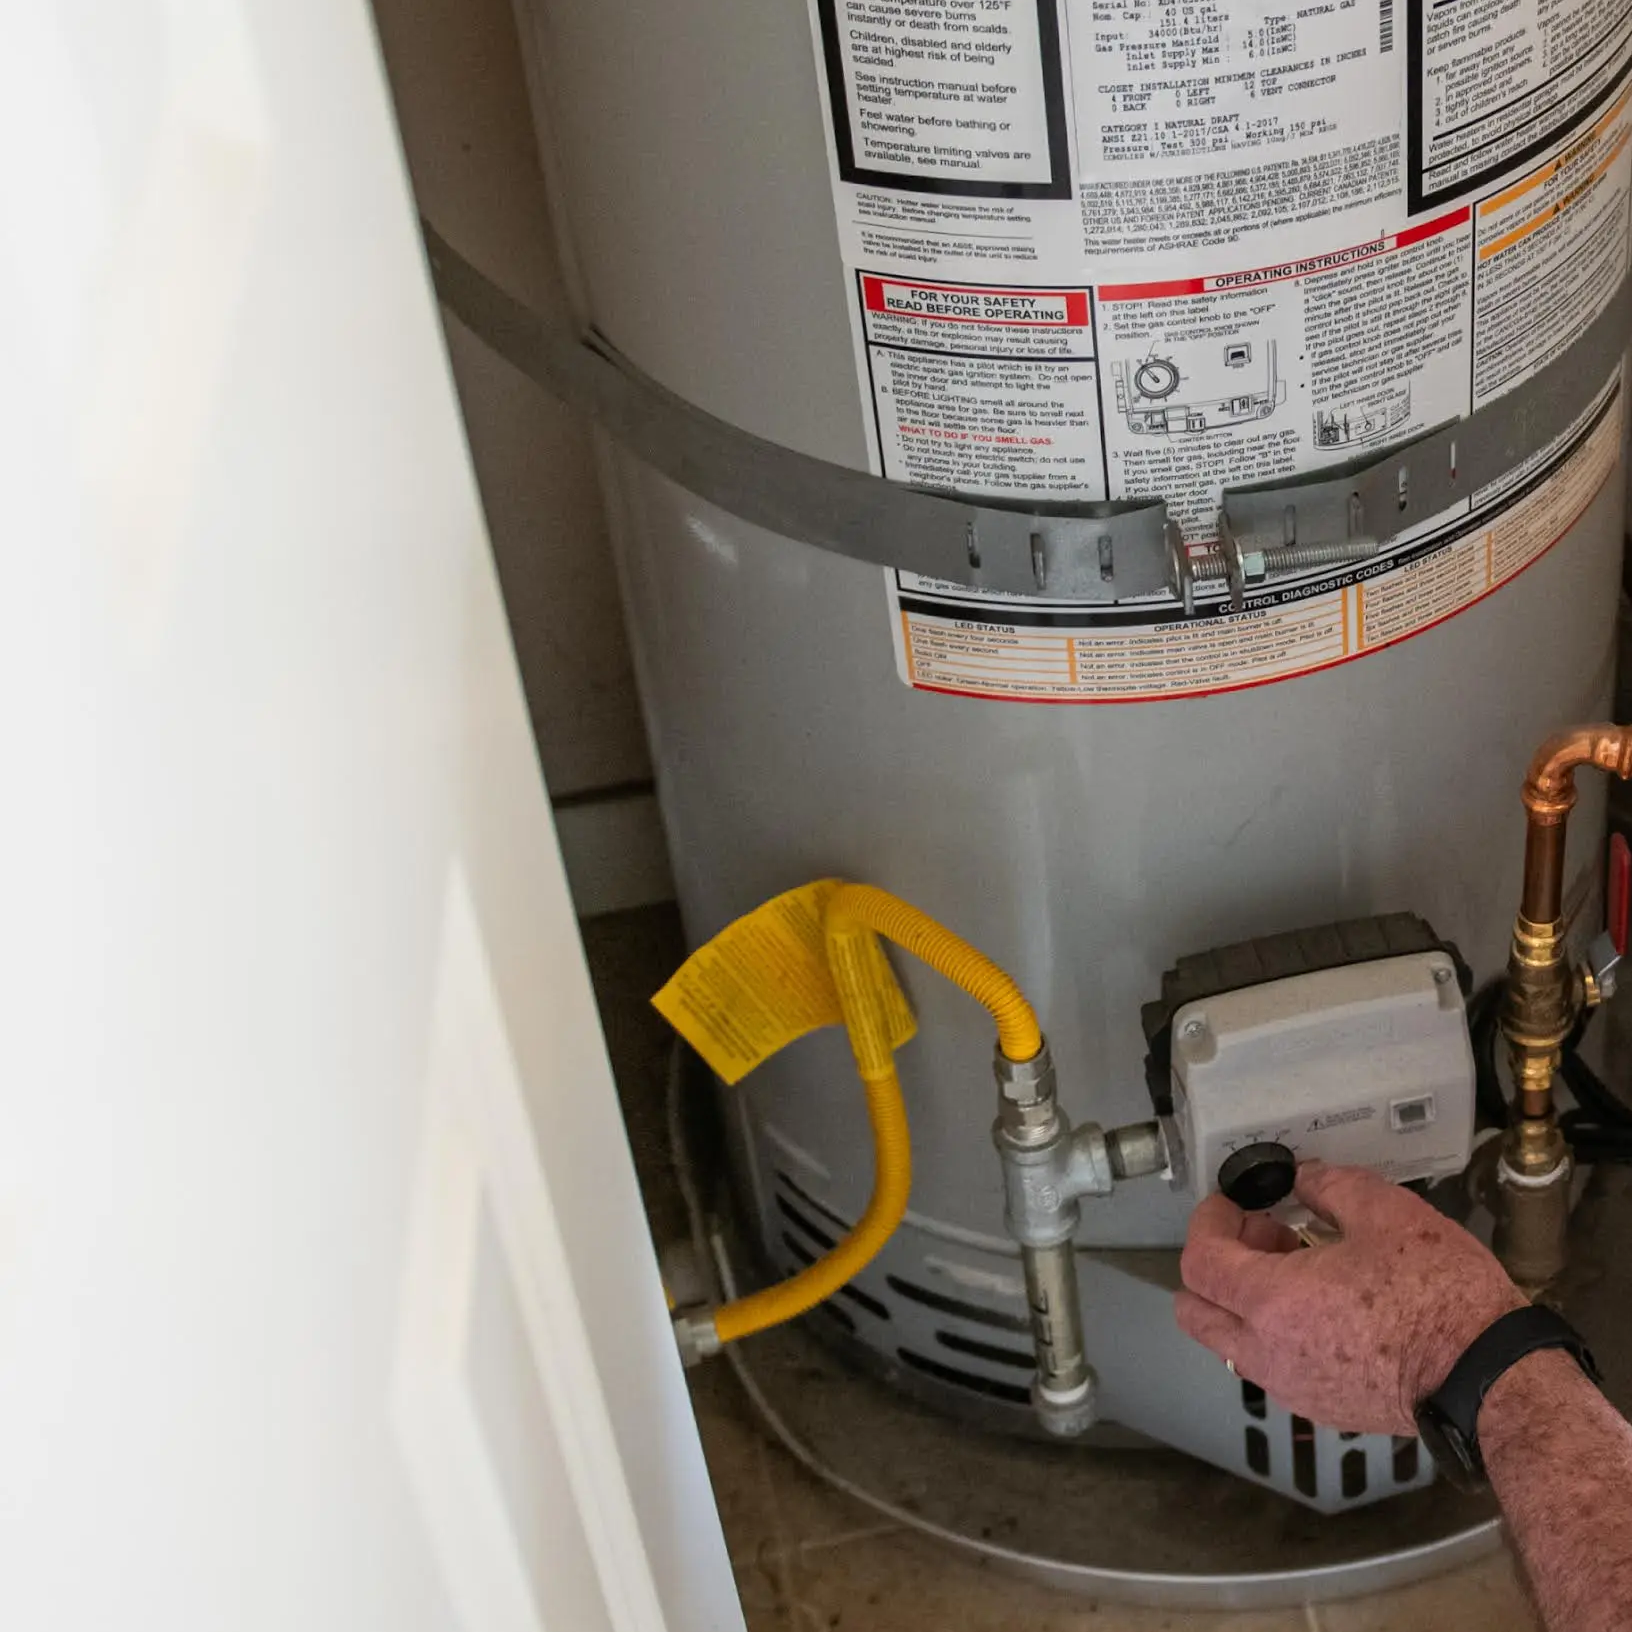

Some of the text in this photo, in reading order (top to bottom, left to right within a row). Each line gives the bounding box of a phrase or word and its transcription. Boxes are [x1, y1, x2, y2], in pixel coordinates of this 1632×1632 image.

[846, 1, 976, 21] can cause severe burns
[950, 0, 975, 9] over
[1092, 0, 1128, 10] Serial
[1165, 8, 1176, 16] 40
[1182, 6, 1194, 15] US
[1194, 13, 1230, 24] liters
[1297, 5, 1335, 19] NATURAL
[1340, 0, 1356, 9] GAS
[847, 13, 892, 28] instantly
[895, 18, 906, 27] or
[909, 18, 940, 31] death
[943, 22, 969, 32] from
[849, 30, 1012, 54] Children, disabled and elderly
[851, 42, 995, 66] are at highest risk of being
[1098, 48, 1366, 93] CLOSET INSTALLATION MINIMUM CLEARANCES IN INCHES
[855, 71, 1017, 94] See instruction manual before
[856, 81, 1008, 104] setting temperature at water
[1122, 78, 1278, 102] FRONT LEFT TOP
[1122, 75, 1336, 112] BACK RIGHT VENT CONNECTOR
[860, 108, 1011, 132] Feel water before bathing or
[1101, 123, 1148, 133] CATEGORY
[1165, 119, 1205, 129] NATURAL
[1211, 114, 1240, 123] DRAFT
[863, 136, 1031, 160] Temperature limiting valves are
[864, 149, 914, 165] available,
[917, 155, 937, 166] see
[1215, 241, 1385, 288] OPERATING INSTRUCTIONS
[886, 298, 1065, 321] READ BEFORE OPERATING
[910, 290, 1036, 308] FOR YOUR SAFETY
[1148, 301, 1172, 309] Read
[1191, 296, 1218, 305] safety
[1220, 287, 1267, 301] information
[1113, 322, 1129, 330] Set
[1131, 321, 1146, 329] the
[1148, 321, 1164, 329] gas
[1167, 317, 1197, 326] control
[1199, 314, 1220, 323] knob
[899, 425, 927, 436] WHAT
[929, 428, 942, 438] TO
[944, 430, 958, 440] DO
[972, 433, 993, 443] YOU
[995, 435, 1027, 445] SMELL
[1403, 546, 1454, 574] LED STATUS
[1282, 574, 1355, 599] DIAGNOSTIC
[1355, 559, 1395, 580] CODES
[954, 611, 1267, 634] LED STATUS OPERATIONAL STATUS
